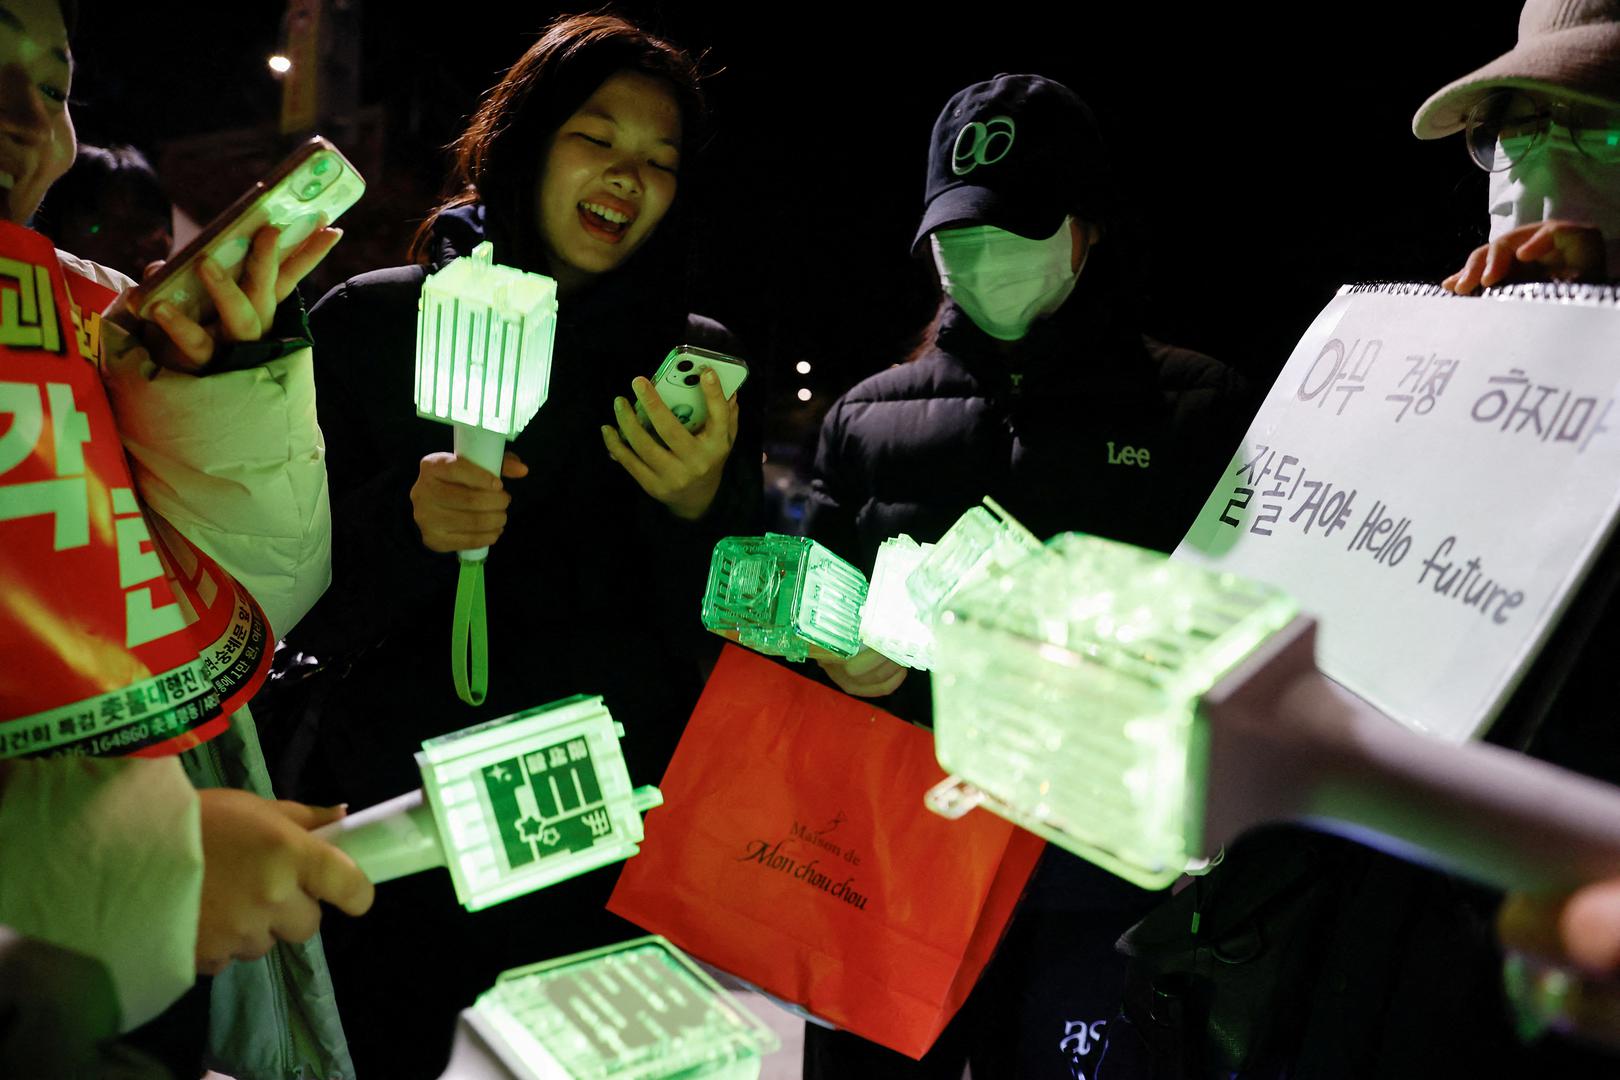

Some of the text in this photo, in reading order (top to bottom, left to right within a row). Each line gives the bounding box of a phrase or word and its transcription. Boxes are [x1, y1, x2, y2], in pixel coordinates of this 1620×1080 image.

[1297, 338, 1614, 454] 아무 걱정 하지마
[1107, 441, 1150, 468] Lee
[1346, 500, 1413, 567] Hello
[1417, 536, 1525, 626] future
[101, 667, 199, 727] 촛불대행진
[790, 820, 861, 866] Maison de
